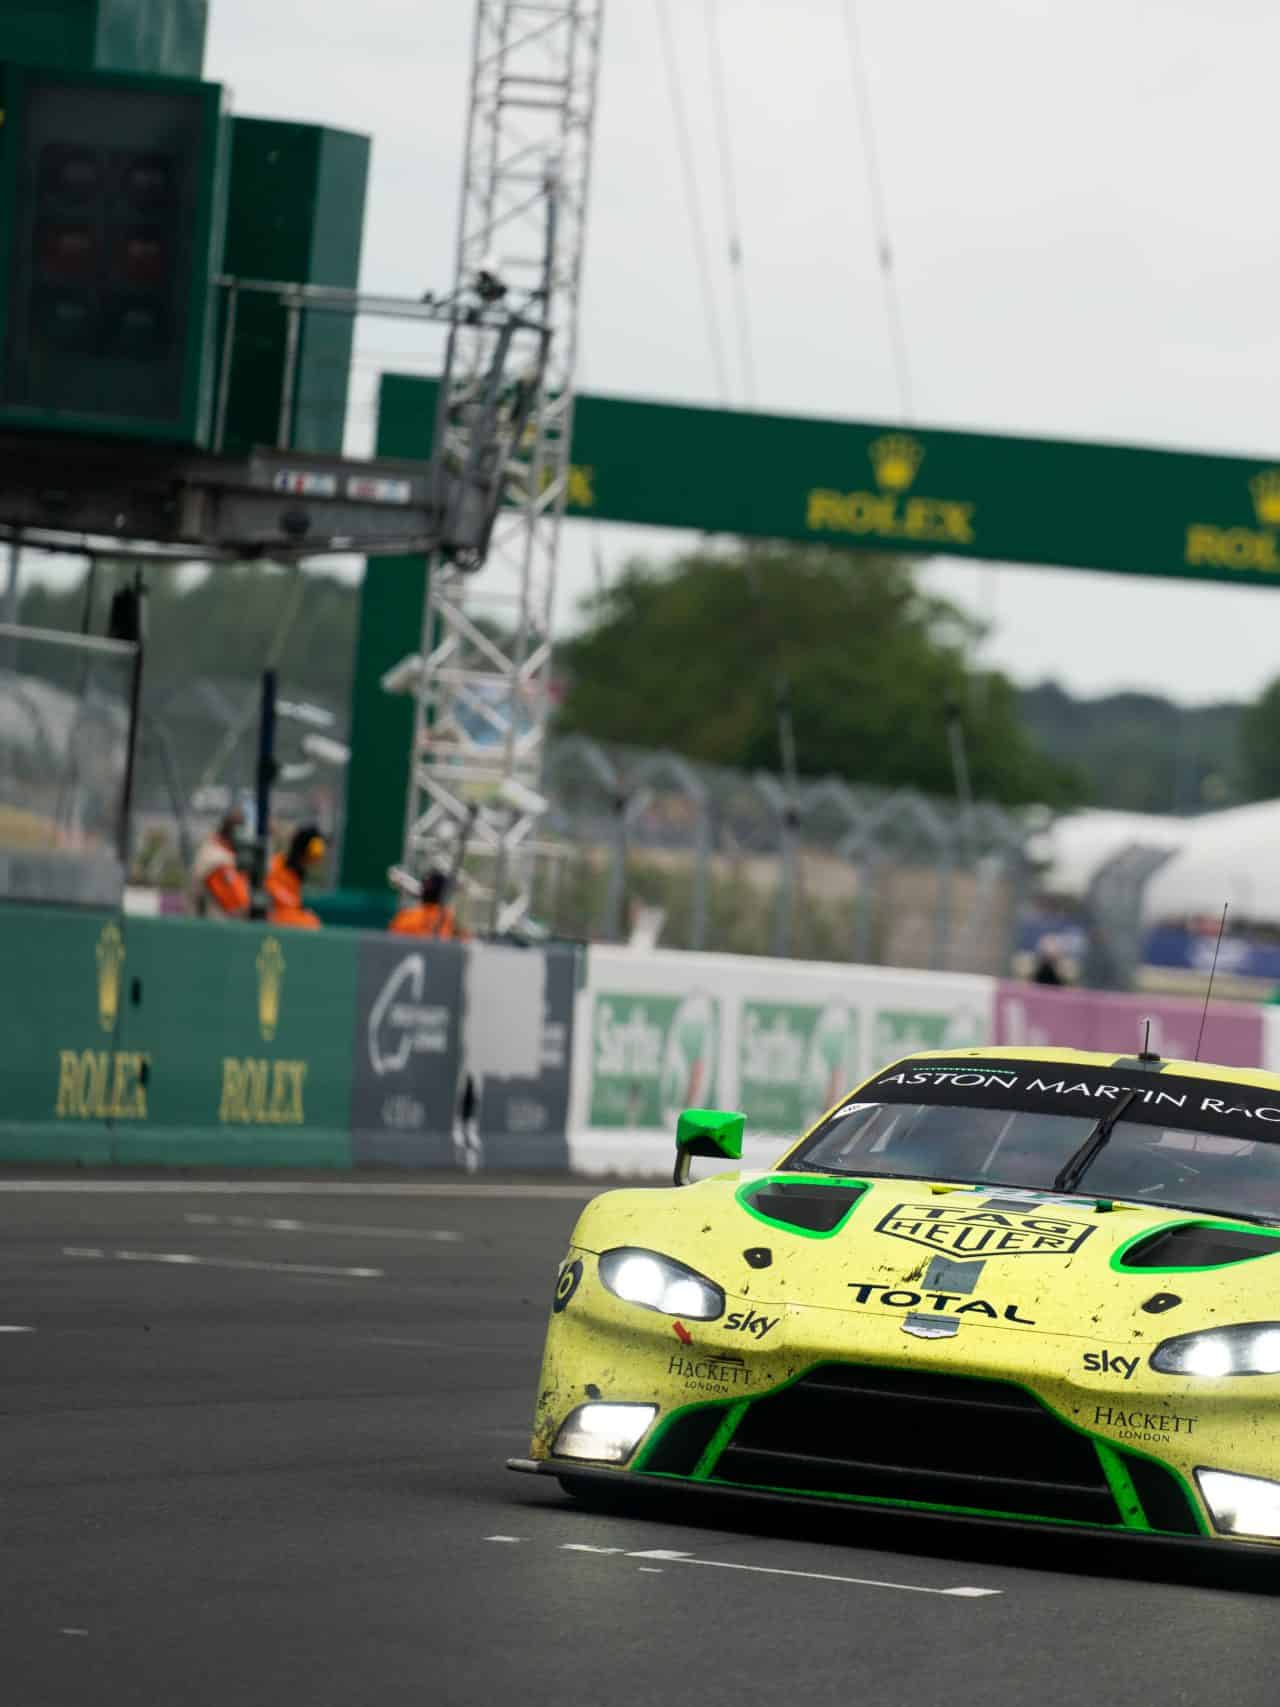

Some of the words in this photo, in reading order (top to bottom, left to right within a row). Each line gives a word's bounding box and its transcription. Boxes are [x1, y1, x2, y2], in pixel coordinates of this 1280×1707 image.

[806, 488, 976, 544] ROLEX
[55, 1048, 150, 1120] ROLEX
[218, 1056, 308, 1125] ROLEX
[877, 1072, 1018, 1090] ASTON
[913, 1207, 1074, 1234] TAG
[891, 1220, 1066, 1251] HEUER
[847, 1283, 1037, 1325] TOTAL
[723, 1310, 781, 1340] sky
[667, 1356, 753, 1385] HACKETT
[1083, 1350, 1140, 1379] sky
[684, 1382, 729, 1394] LONDON
[1094, 1406, 1200, 1434] HACKETT
[1119, 1430, 1170, 1443] LONDON
